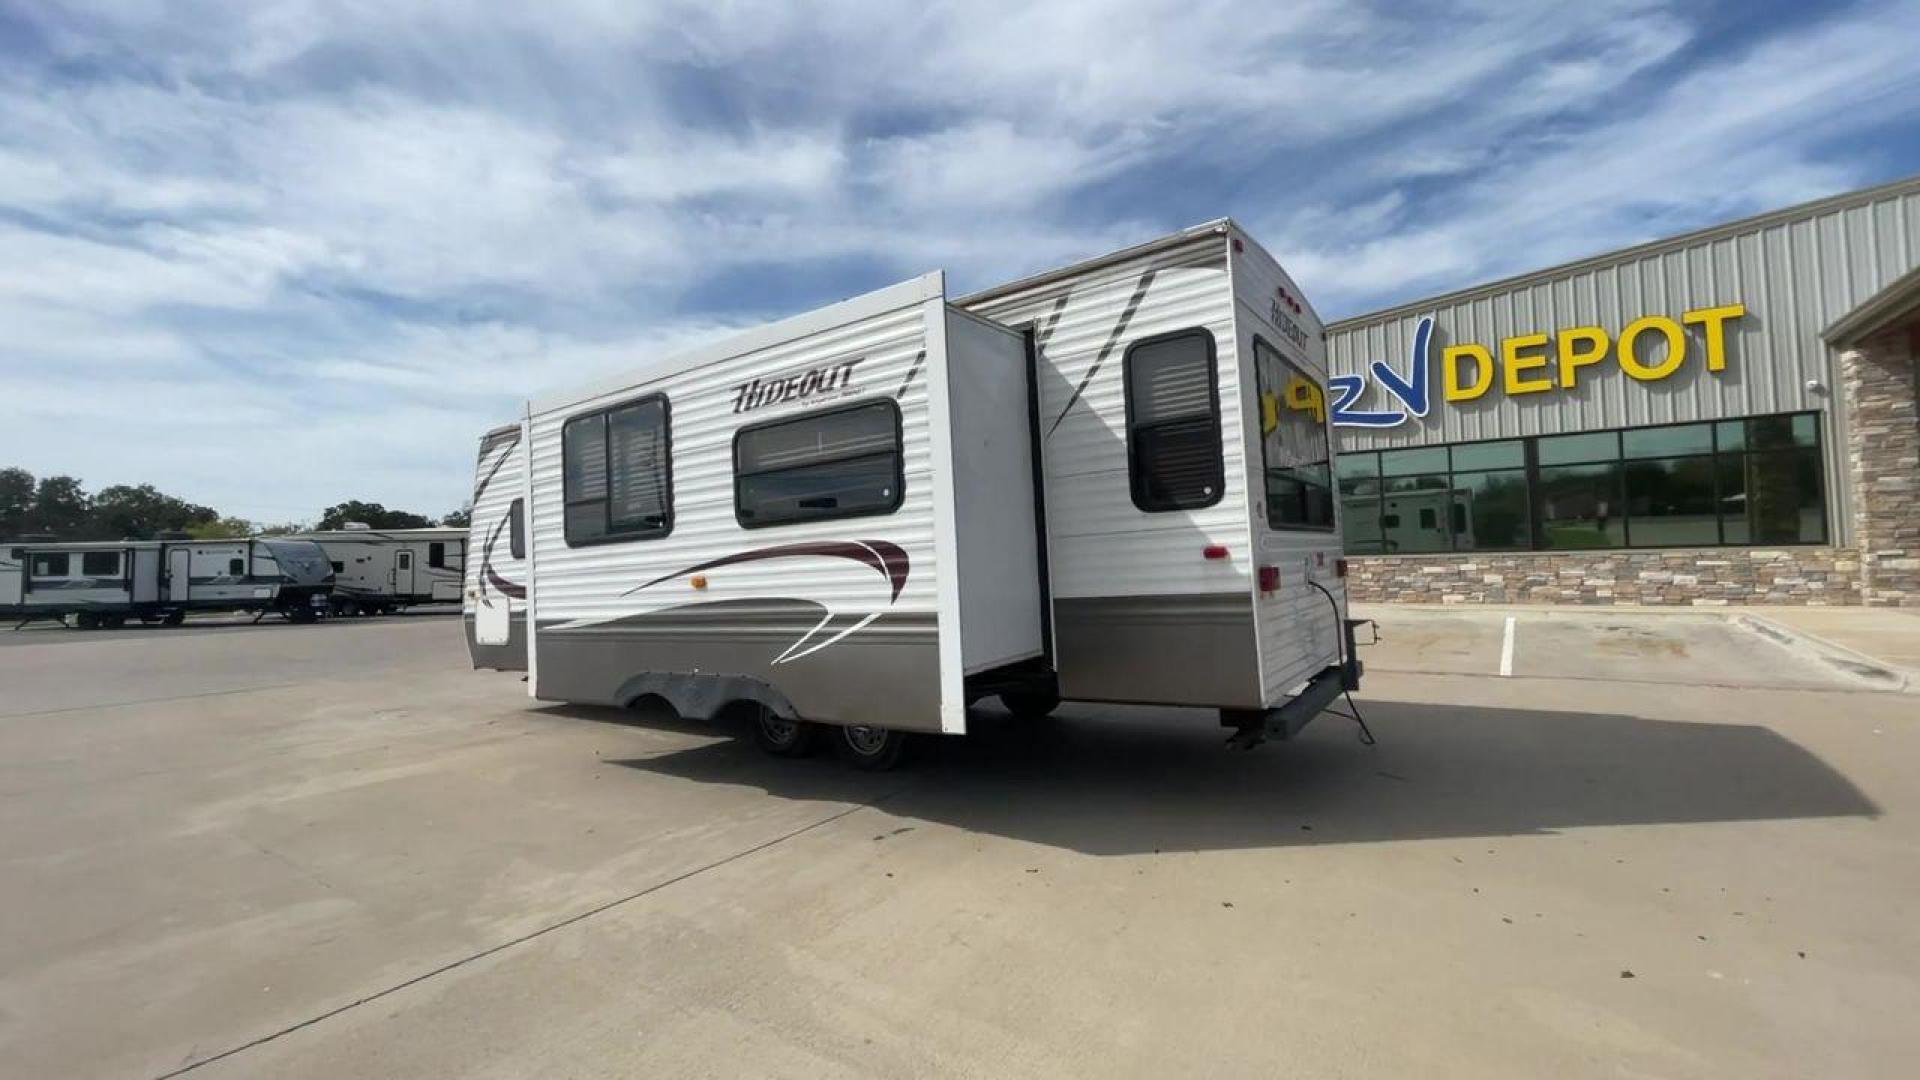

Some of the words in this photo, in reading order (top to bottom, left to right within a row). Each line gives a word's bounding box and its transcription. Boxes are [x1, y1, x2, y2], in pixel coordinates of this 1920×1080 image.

[1271, 298, 1308, 350] HIDEOUT
[1442, 304, 1745, 402] DEPOT
[731, 357, 864, 413] HIDEOUT
